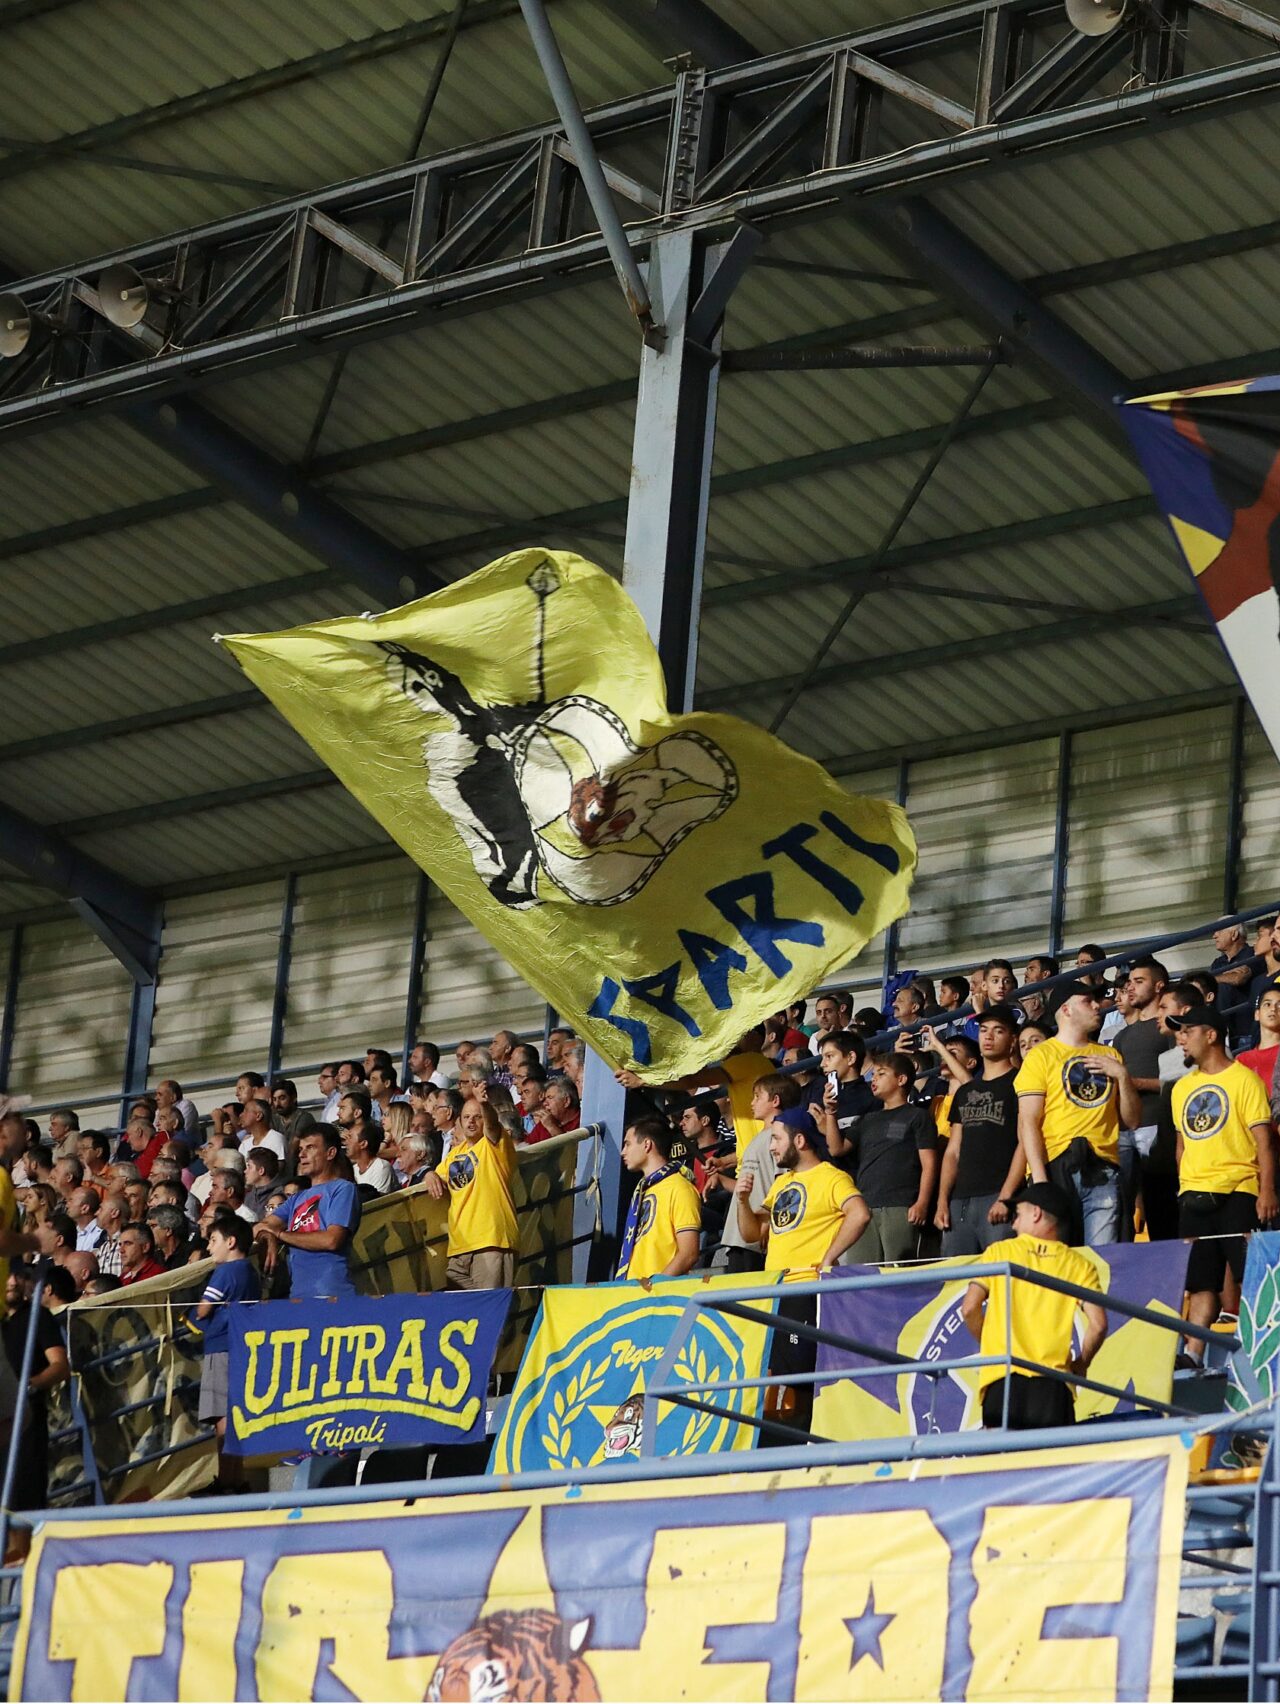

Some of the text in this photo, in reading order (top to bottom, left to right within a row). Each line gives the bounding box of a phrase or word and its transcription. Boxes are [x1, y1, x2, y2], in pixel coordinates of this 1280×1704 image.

[588, 810, 900, 1066] SPARTI
[244, 1319, 479, 1414] ULTRAS
[305, 1416, 387, 1450] Tripoli
